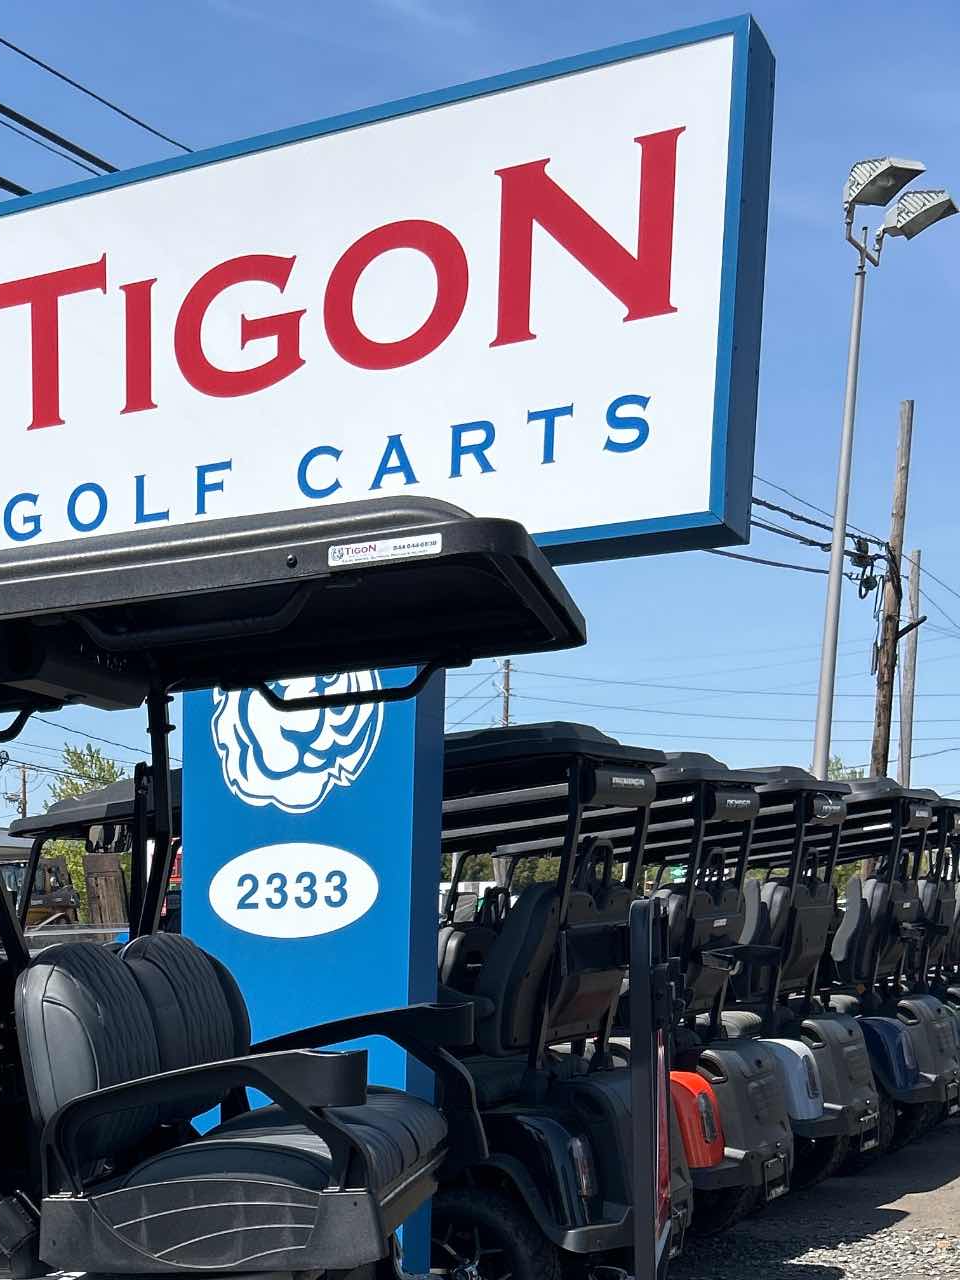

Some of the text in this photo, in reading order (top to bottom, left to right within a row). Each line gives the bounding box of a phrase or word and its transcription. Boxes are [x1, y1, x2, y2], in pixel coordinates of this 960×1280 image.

[2, 393, 652, 542] GOLF CARTS
[344, 544, 377, 556] TIGON
[236, 869, 349, 911] 2333
